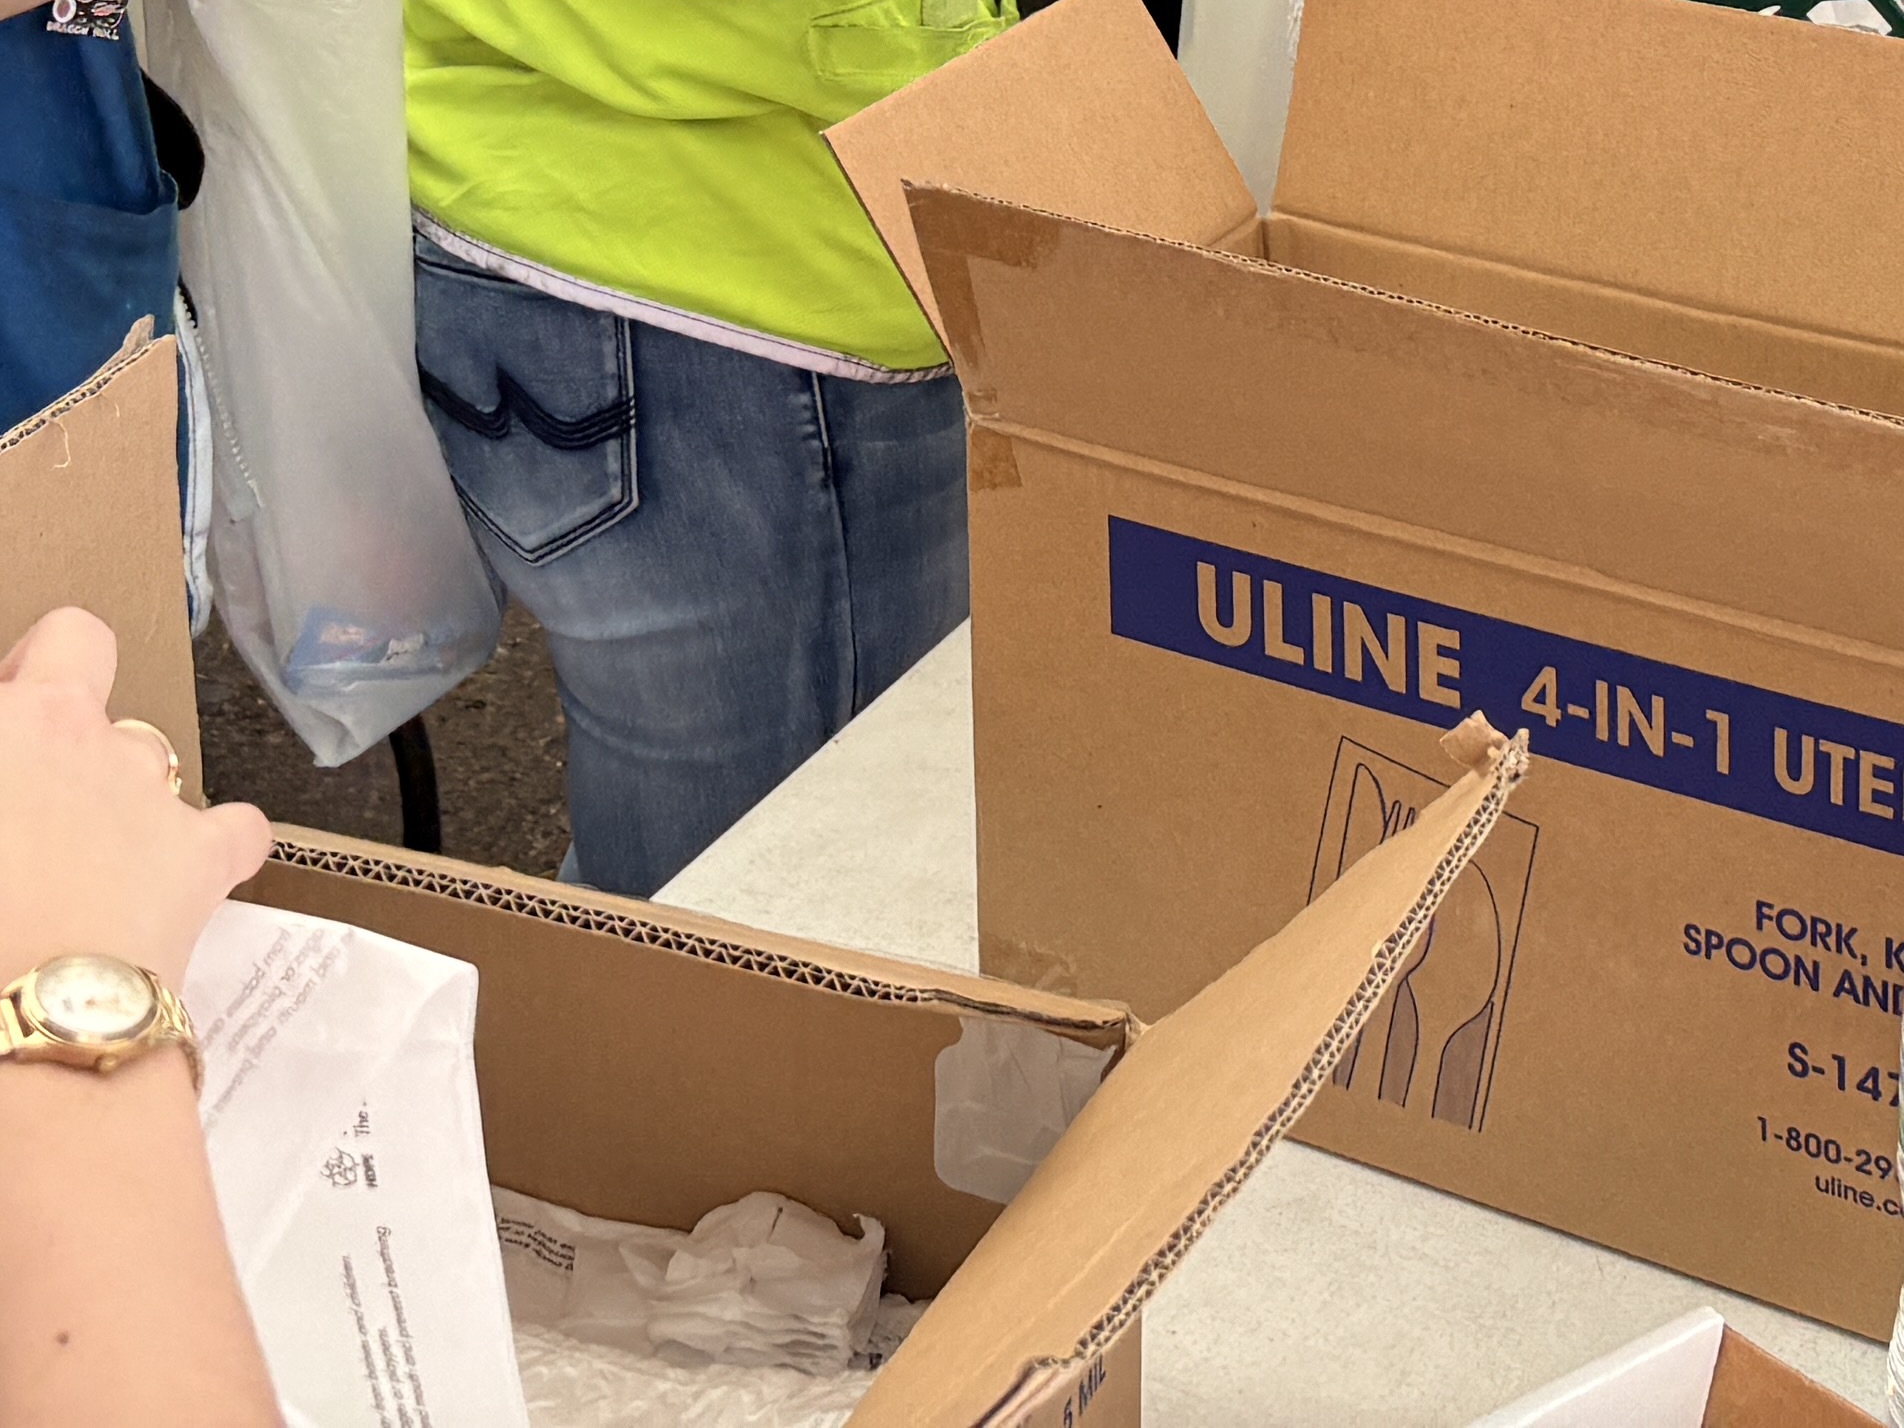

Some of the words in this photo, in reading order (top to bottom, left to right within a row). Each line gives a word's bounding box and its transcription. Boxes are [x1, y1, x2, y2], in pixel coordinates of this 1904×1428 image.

[1195, 559, 1463, 710] ULINE
[1519, 664, 1736, 776] 4-IN-1
[1682, 922, 1821, 994] SPOON
[1754, 898, 1870, 968] FORK,
[1786, 1040, 1902, 1109] S-147
[1756, 1115, 1895, 1181] 1-800-29
[1078, 1353, 1107, 1416] MIL
